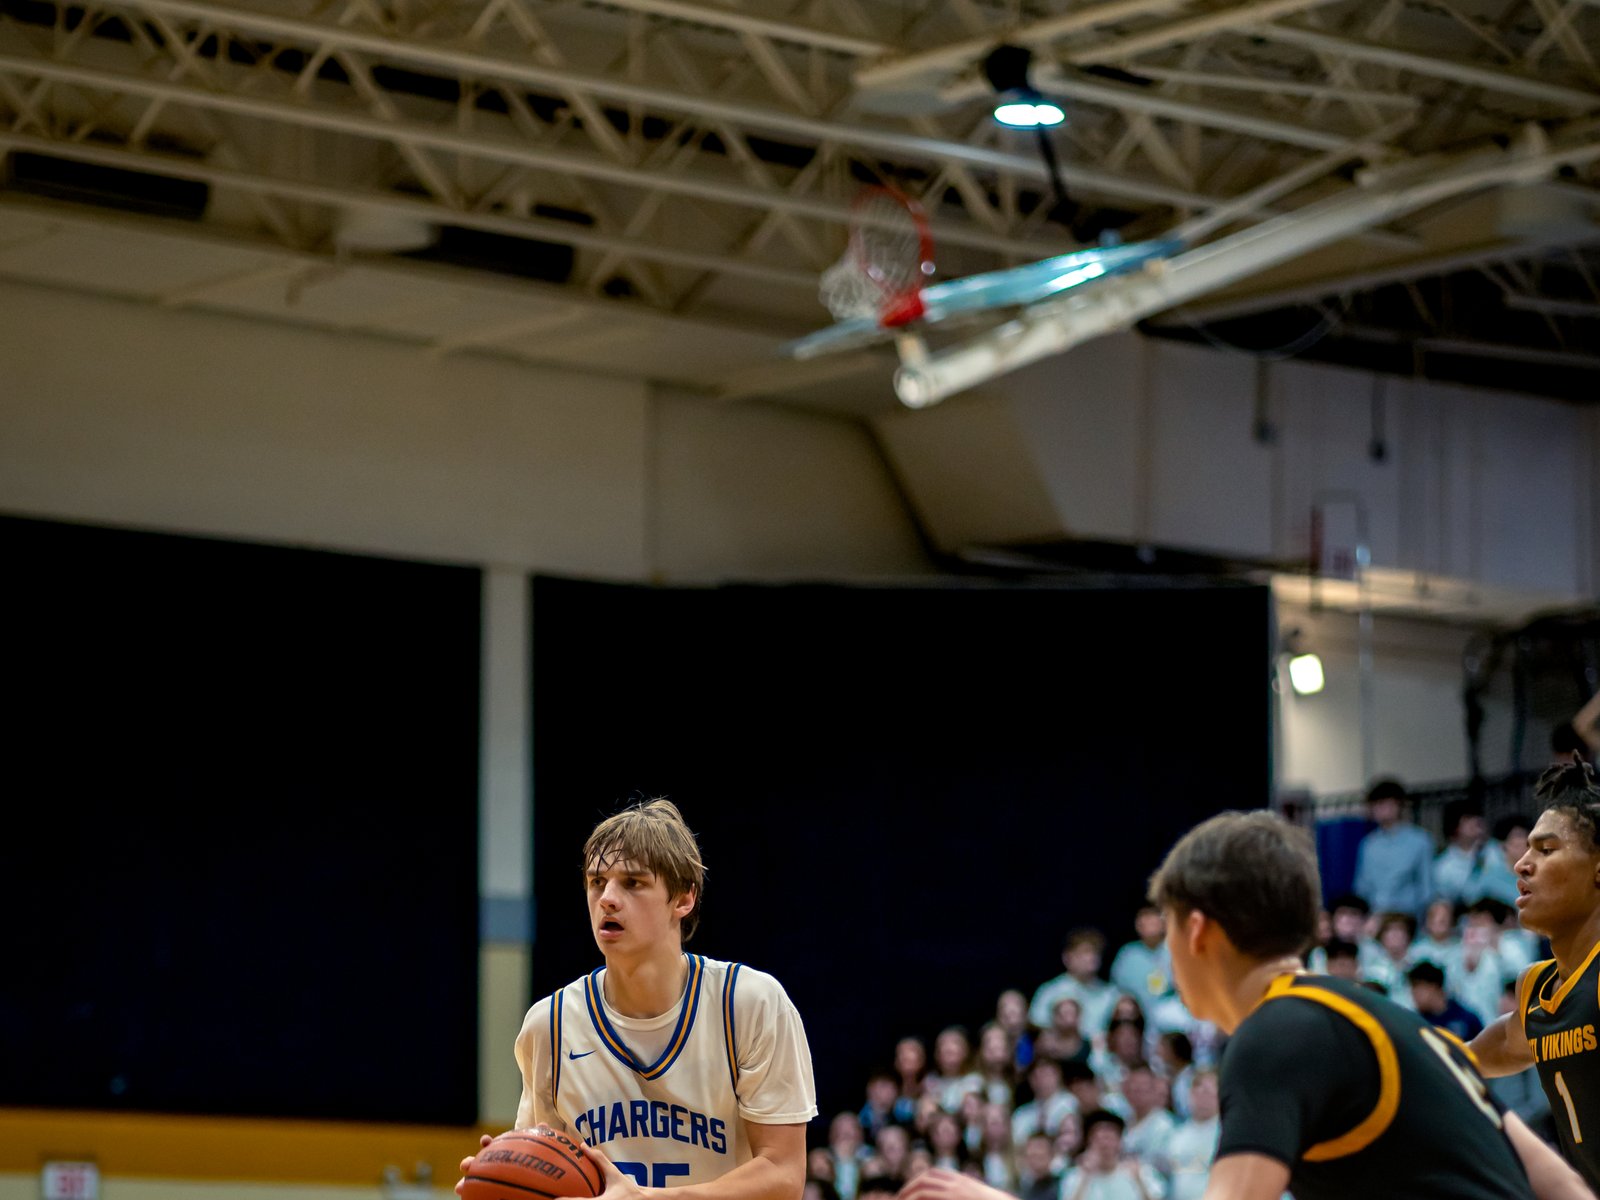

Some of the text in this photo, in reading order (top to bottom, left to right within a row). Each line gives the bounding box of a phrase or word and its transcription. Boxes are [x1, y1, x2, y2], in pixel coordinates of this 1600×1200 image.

[1542, 1024, 1598, 1062] VIKINGS
[575, 1100, 727, 1155] CHARGERS
[1555, 1071, 1583, 1144] 1
